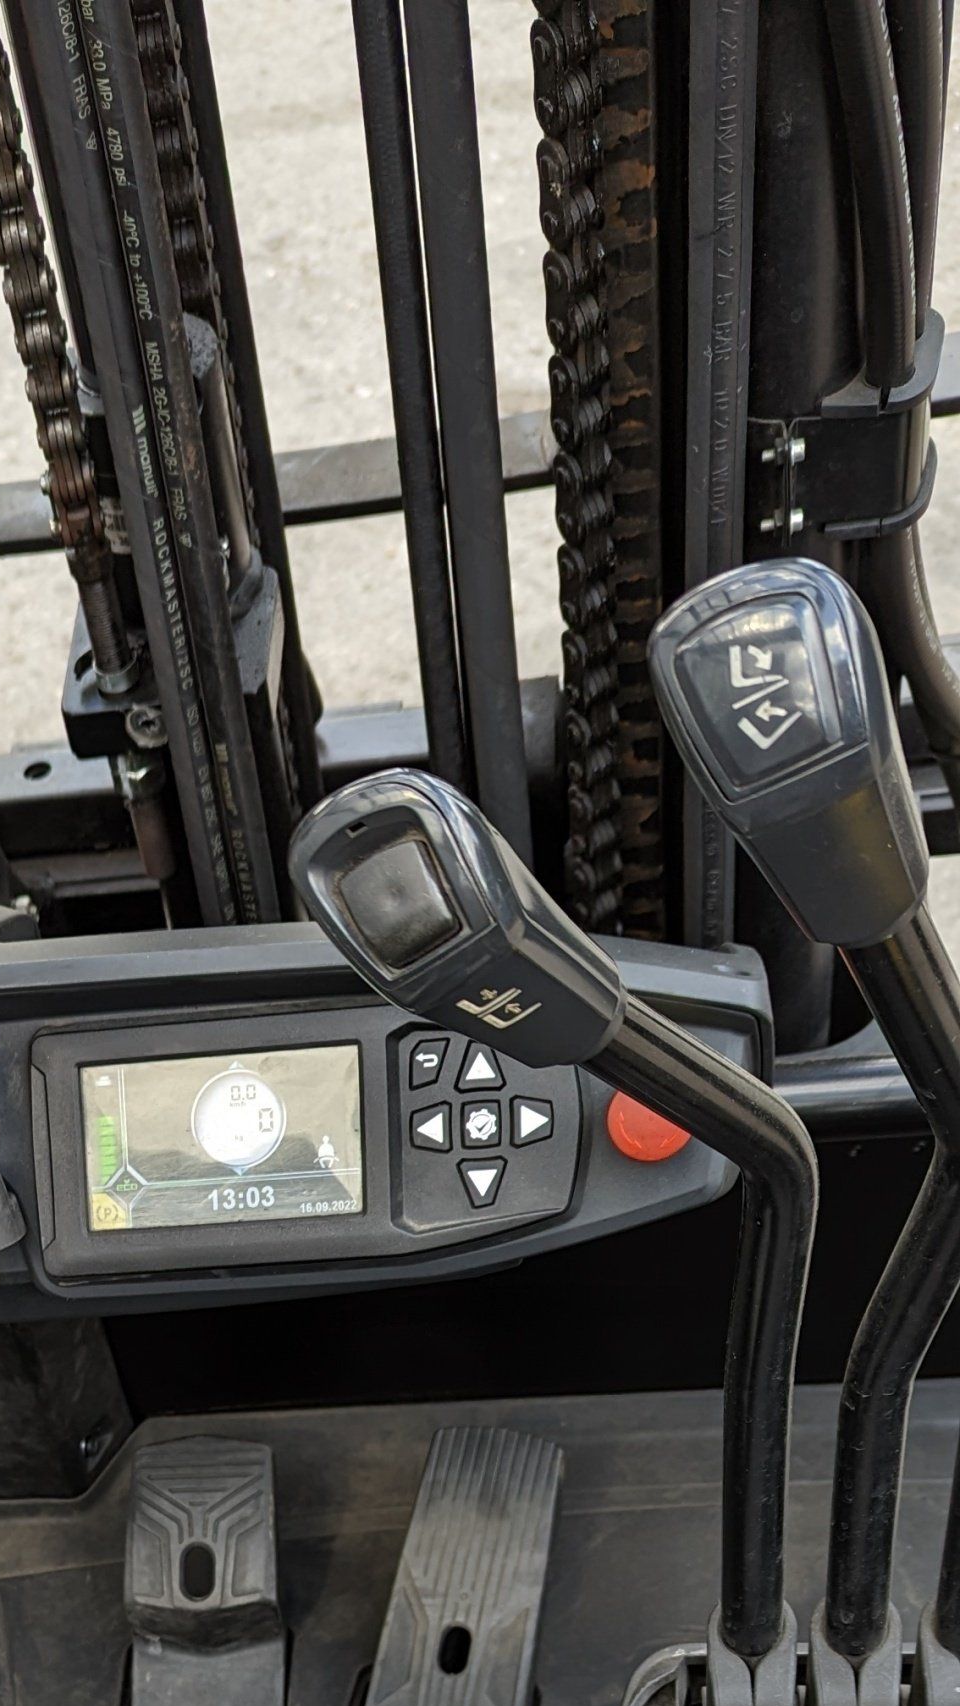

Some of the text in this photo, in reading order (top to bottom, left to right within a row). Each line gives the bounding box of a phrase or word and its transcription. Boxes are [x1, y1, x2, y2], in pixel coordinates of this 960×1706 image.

[72, 74, 91, 120] FRAS
[95, 78, 113, 110] MPa
[105, 127, 124, 160] 4780
[112, 167, 130, 187] psi
[129, 254, 142, 267] to
[144, 341, 164, 381] MSHA
[169, 487, 188, 521] FRAS
[151, 517, 195, 691] ROCKMASTER/2SC
[229, 828, 258, 924] ROCKMASTE
[230, 1084, 257, 1101] 0.0
[207, 1186, 275, 1211] 13:03
[299, 1199, 358, 1214] 16.09.2022
